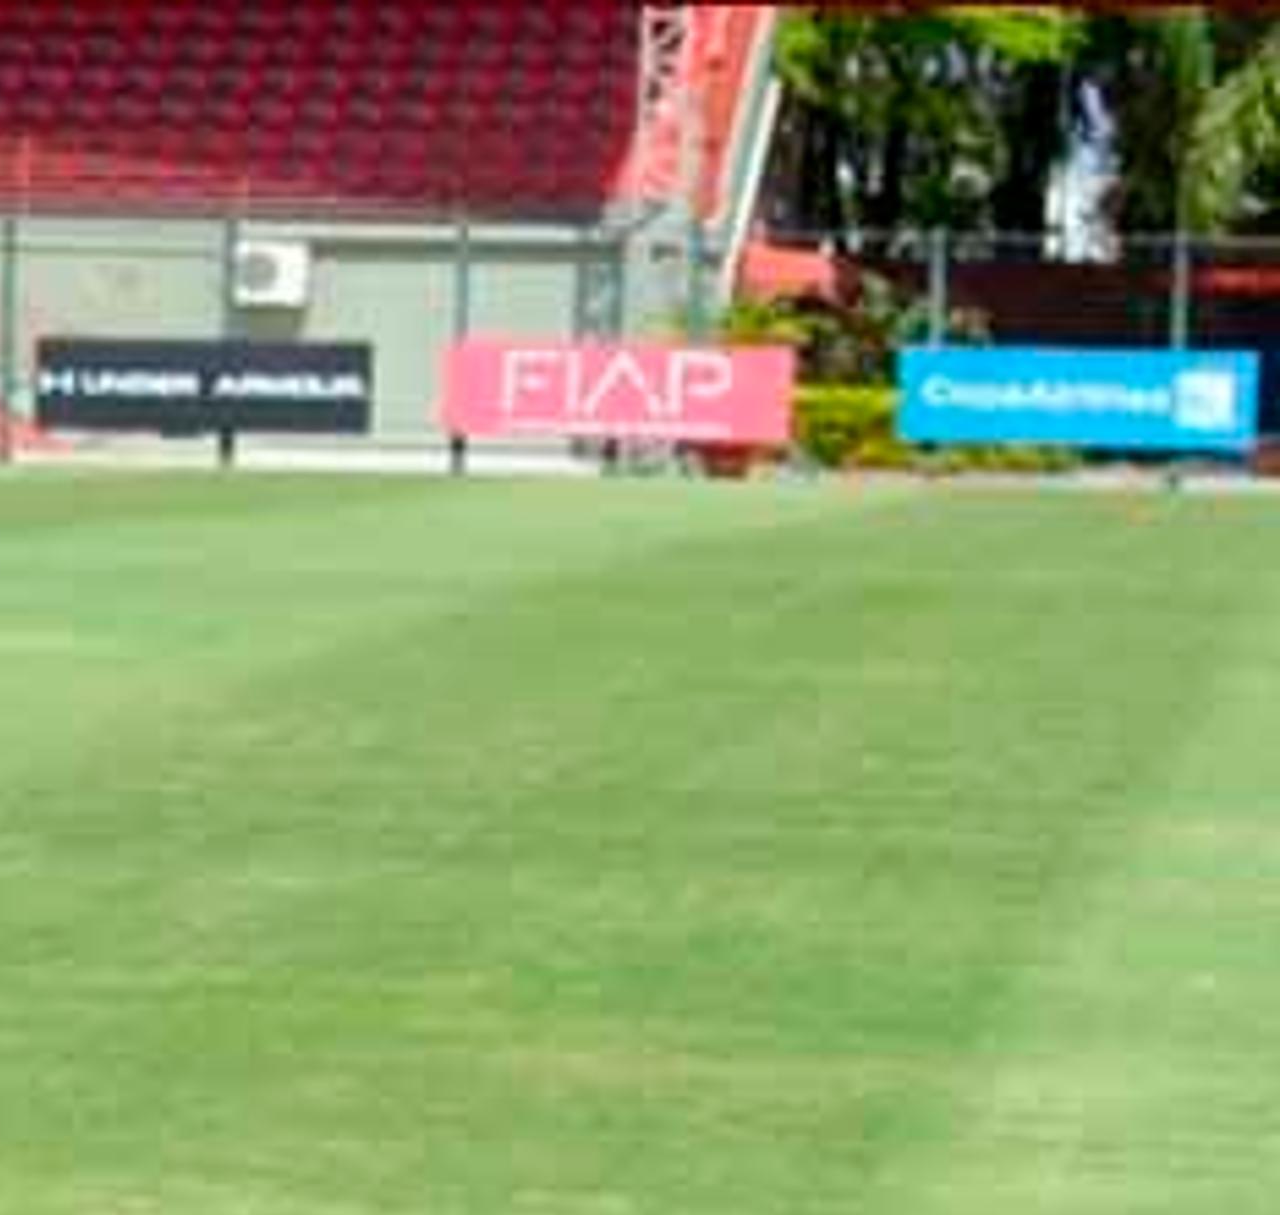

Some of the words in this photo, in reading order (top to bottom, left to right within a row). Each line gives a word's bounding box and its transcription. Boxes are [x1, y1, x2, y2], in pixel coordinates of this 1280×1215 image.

[80, 366, 201, 396] UNDER
[210, 370, 366, 397] ARMOUR
[501, 349, 734, 415] FIAP
